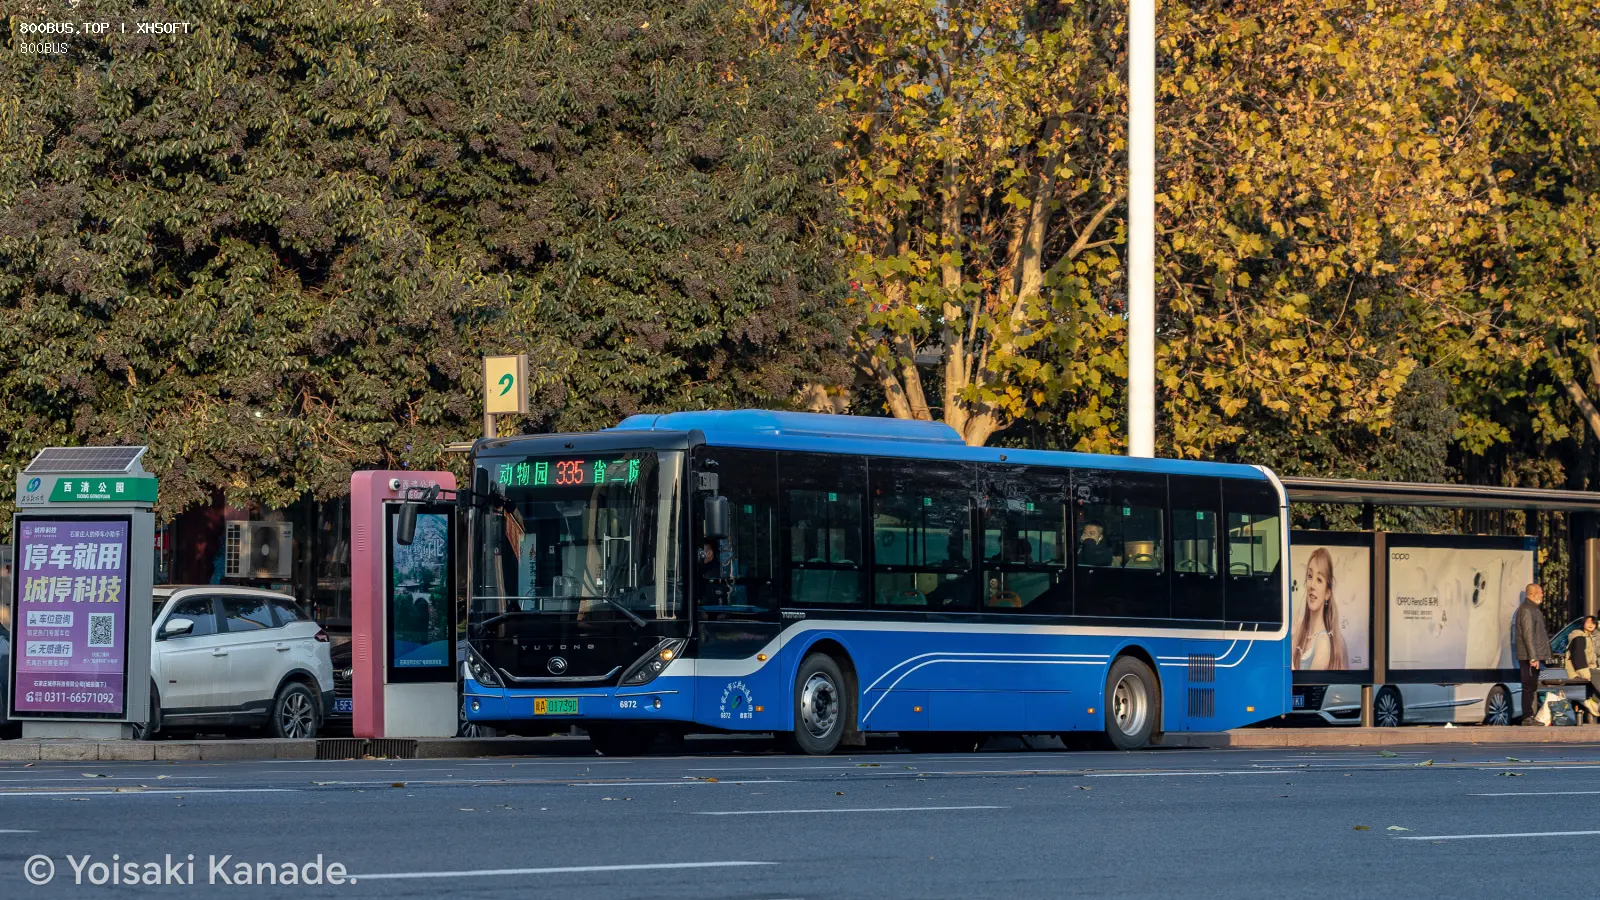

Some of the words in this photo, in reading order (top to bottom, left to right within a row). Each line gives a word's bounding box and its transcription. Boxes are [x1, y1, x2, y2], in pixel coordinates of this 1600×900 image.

[498, 461, 549, 486] 动物园
[555, 460, 585, 485] 335
[592, 458, 641, 484] 省二院
[63, 481, 125, 493] 西清公园
[69, 530, 121, 538] 石家庄人的停车小助手
[23, 542, 123, 571] 停车就用
[23, 576, 121, 603] 城停科技
[39, 614, 71, 625] 车位查询
[37, 644, 70, 655] 无感通行
[44, 691, 114, 704] 0311-66571092
[619, 700, 637, 709] 6872
